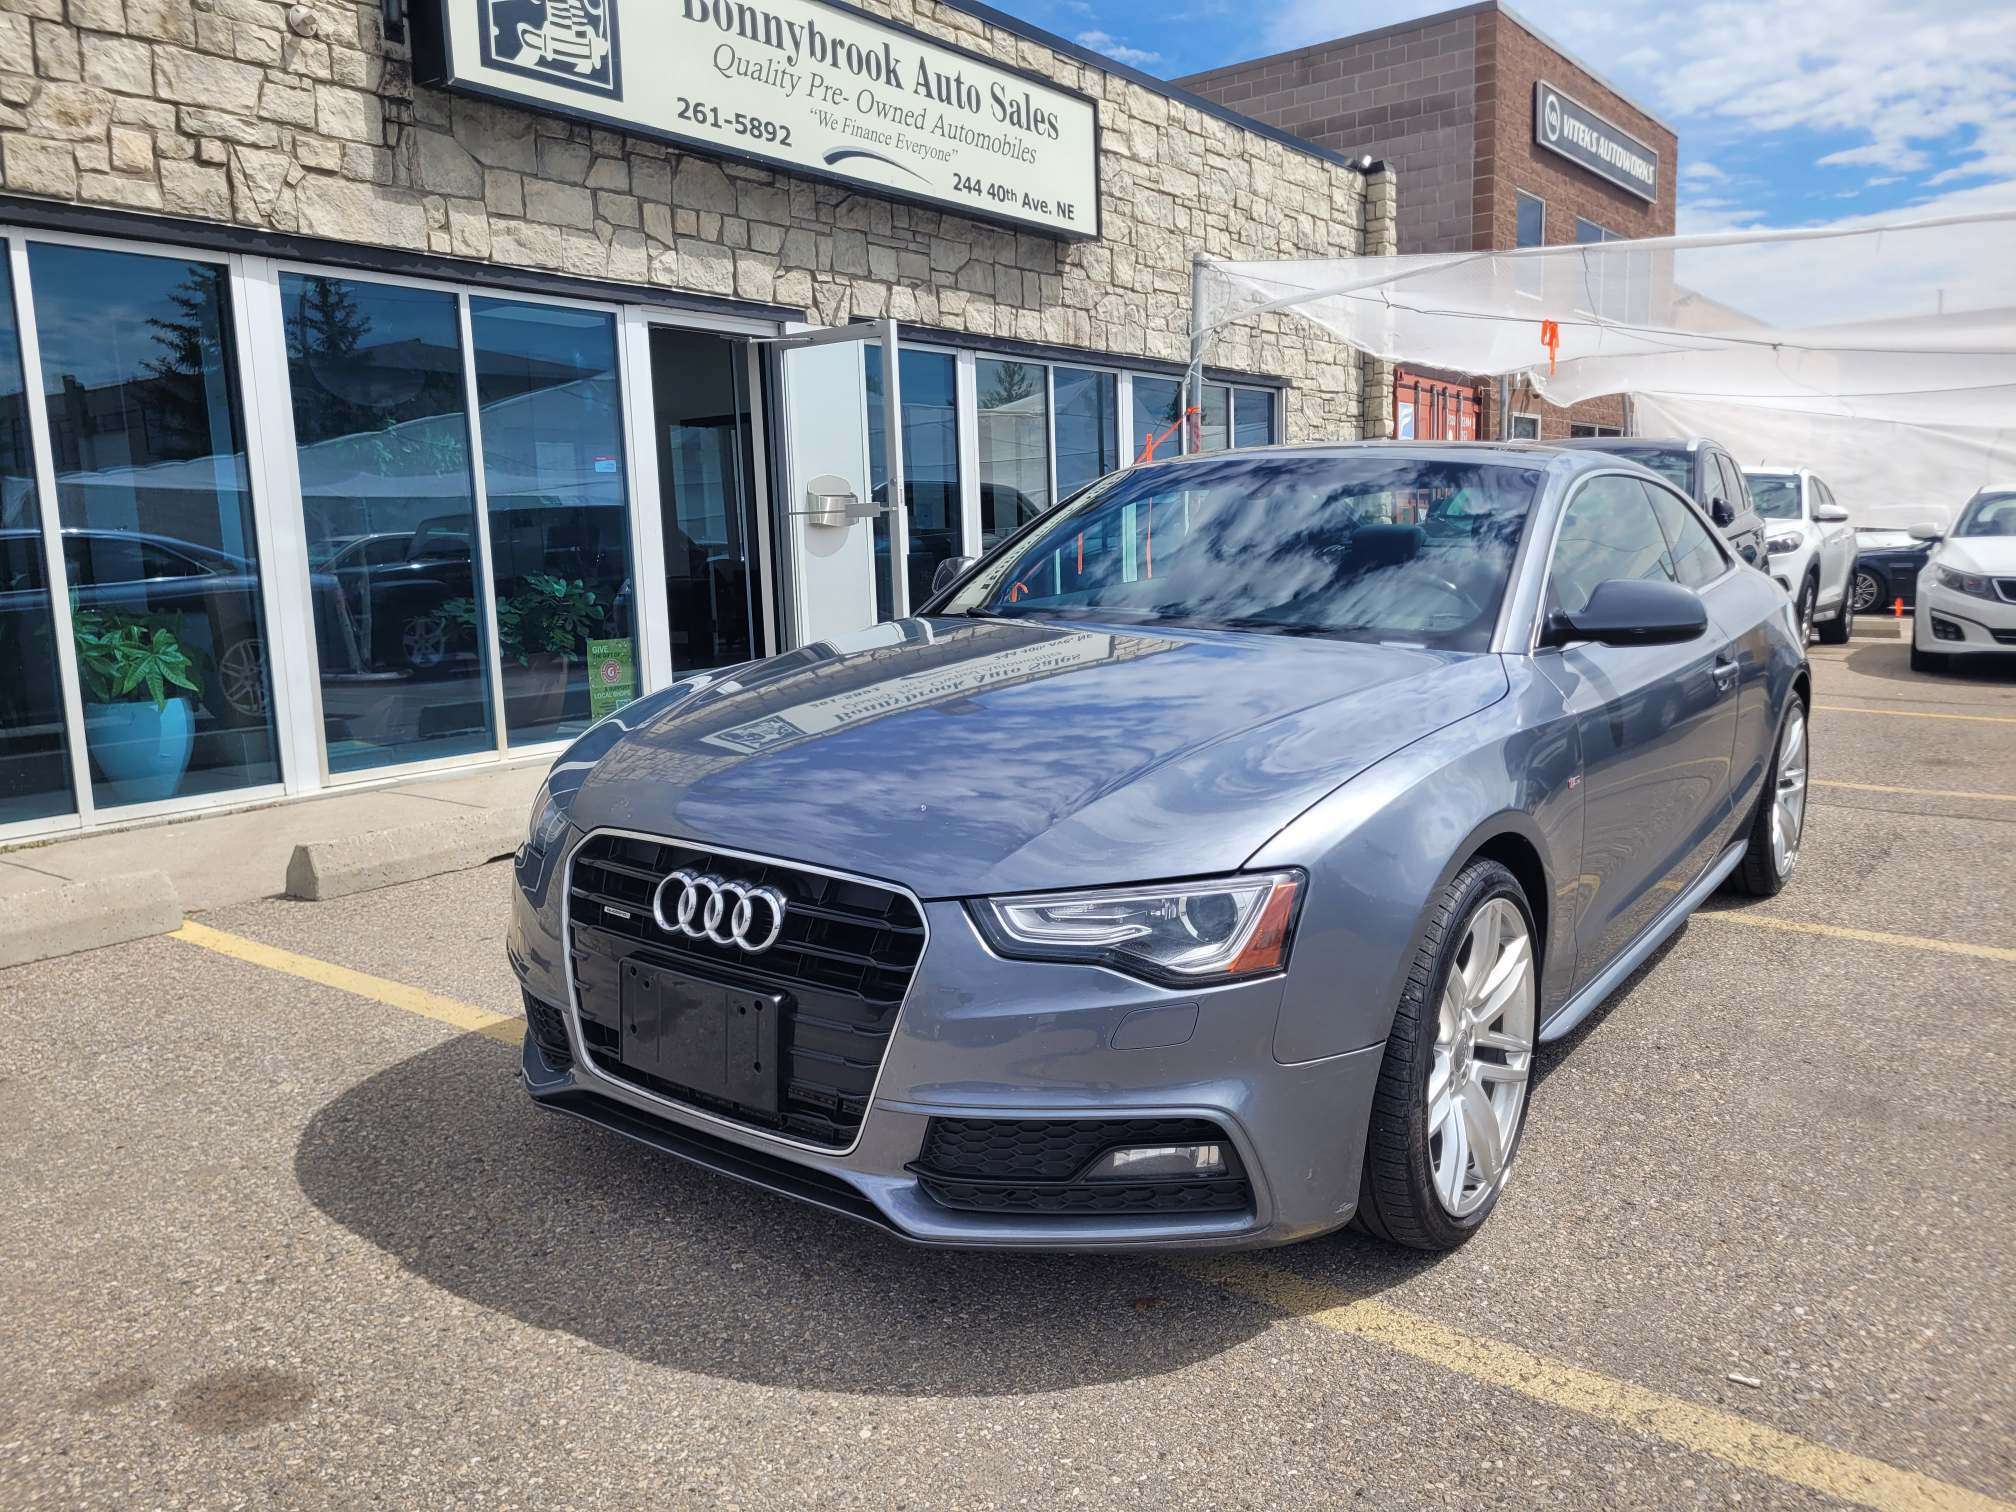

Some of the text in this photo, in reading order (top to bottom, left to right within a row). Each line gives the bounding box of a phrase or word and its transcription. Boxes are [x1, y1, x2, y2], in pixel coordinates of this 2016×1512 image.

[677, 97, 793, 147] 261-5892
[713, 43, 1037, 164] Quality Pre- Owned Automobiles
[913, 56, 981, 114] Auto
[990, 81, 1060, 140] Sales
[842, 118, 892, 145] Finance
[1563, 114, 1655, 184] VITEKS AUTOWORKS
[953, 173, 1075, 220] 244 40th Ave. NE
